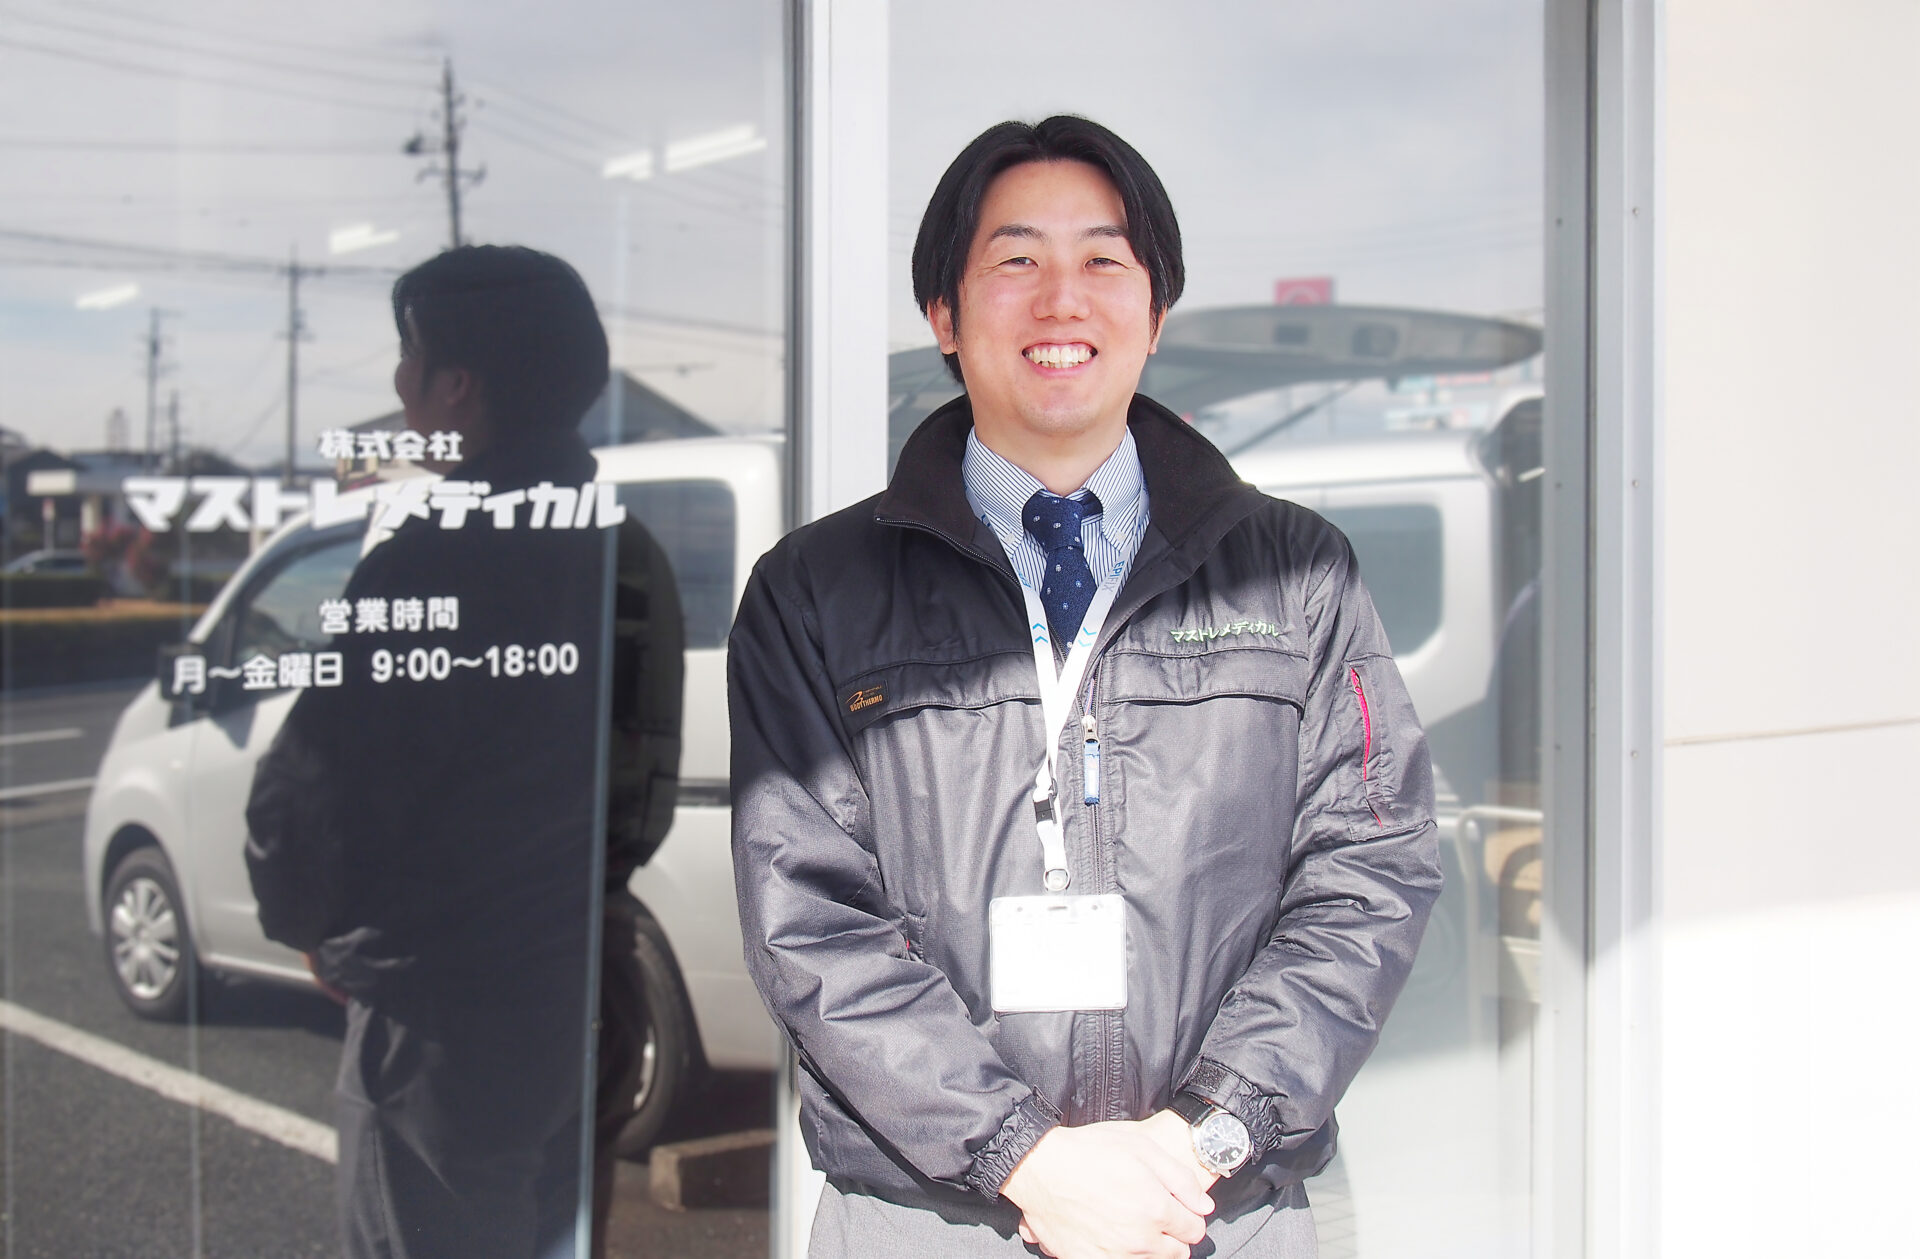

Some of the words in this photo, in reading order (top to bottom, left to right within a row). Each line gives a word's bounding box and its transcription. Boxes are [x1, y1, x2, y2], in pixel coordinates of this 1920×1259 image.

[318, 428, 463, 462] 株式会社
[122, 476, 626, 532] マストレメディカル
[319, 597, 460, 634] 営業時間
[1170, 621, 1279, 643] マストレメディカル
[172, 651, 344, 695] 月～金曜日
[371, 642, 579, 683] 9:00～18:00
